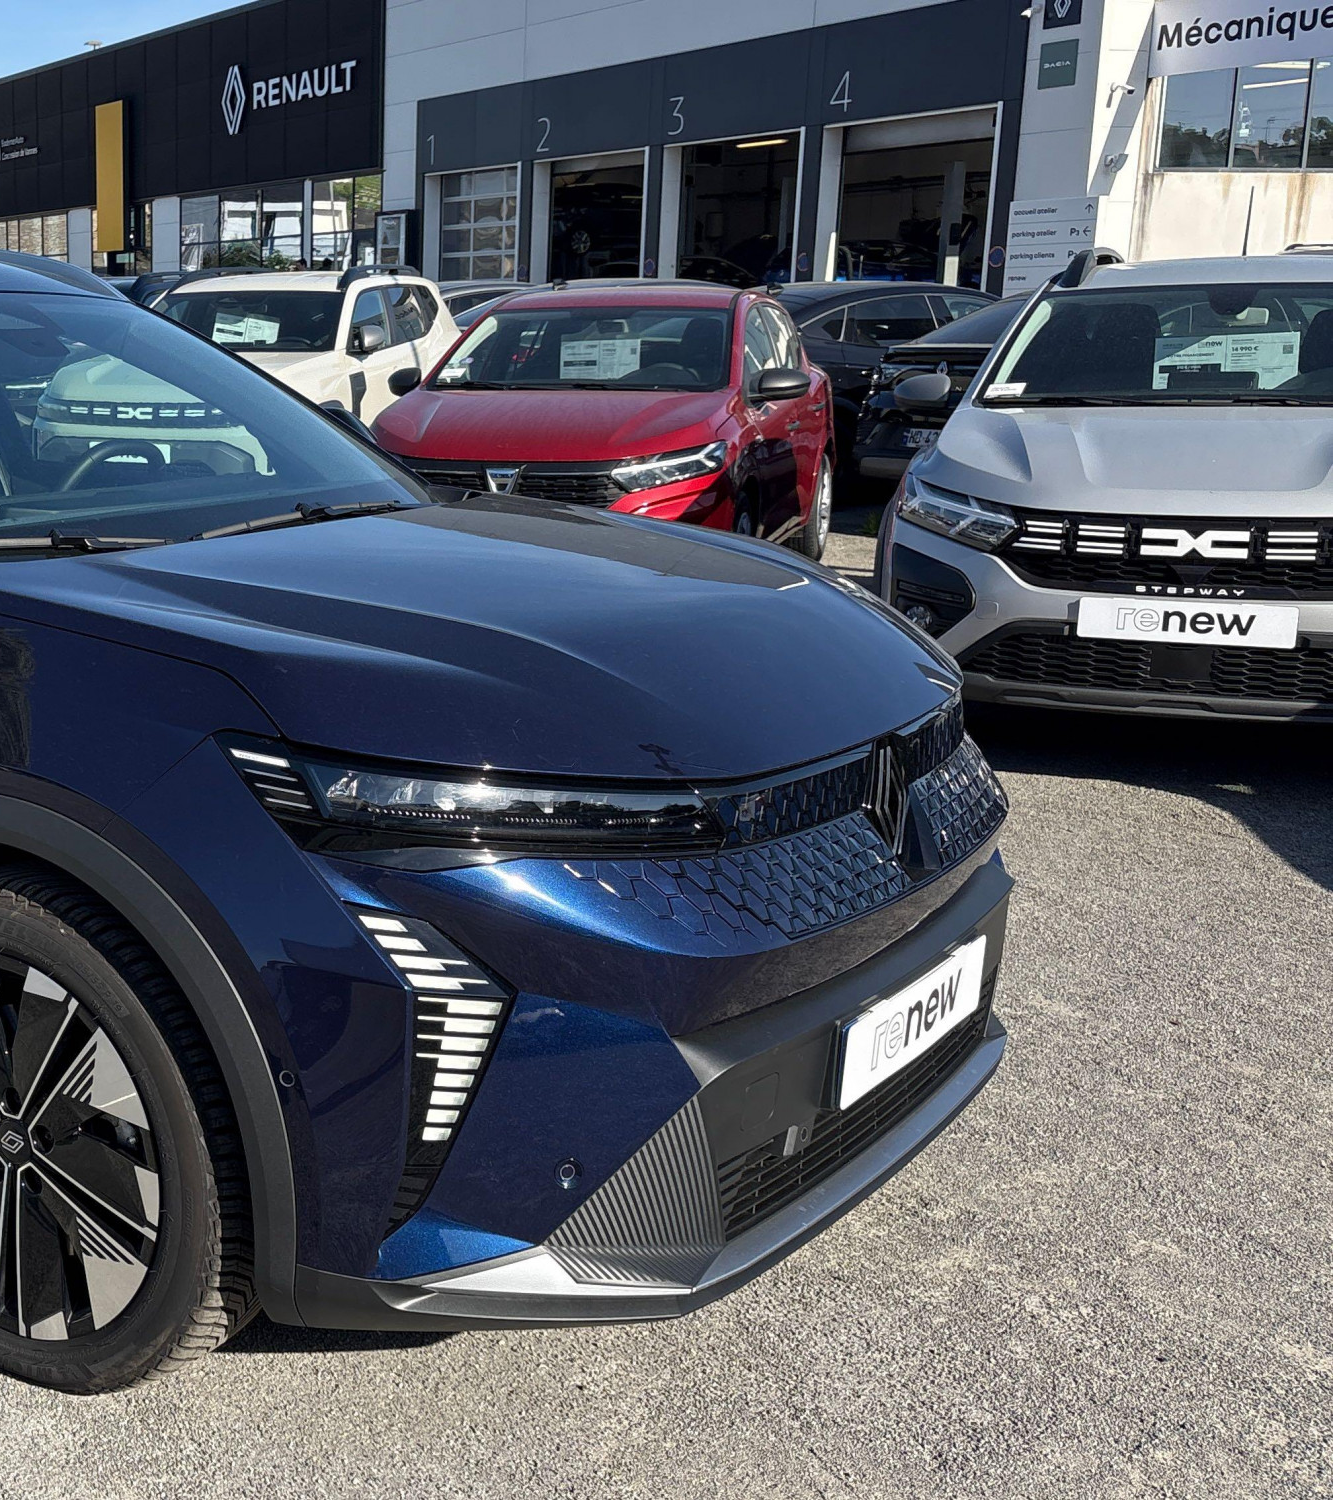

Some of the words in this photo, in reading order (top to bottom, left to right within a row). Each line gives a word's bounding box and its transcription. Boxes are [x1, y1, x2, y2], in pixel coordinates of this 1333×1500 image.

[1157, 5, 1333, 51] Mécanique
[1043, 60, 1071, 69] DACIA
[252, 59, 357, 110] RENAULT
[830, 70, 853, 113] 4
[667, 96, 685, 137] 3
[425, 133, 436, 166] 1
[535, 117, 551, 154] 2
[1013, 208, 1036, 216] accueil
[1036, 207, 1058, 215] atelier
[1011, 230, 1036, 239] parking
[1035, 229, 1058, 237] atelier
[1009, 252, 1033, 261] parking
[1033, 251, 1055, 259] clients
[1135, 585, 1245, 597] STEPWAY
[1116, 607, 1257, 636] renew
[870, 967, 963, 1072] renew
